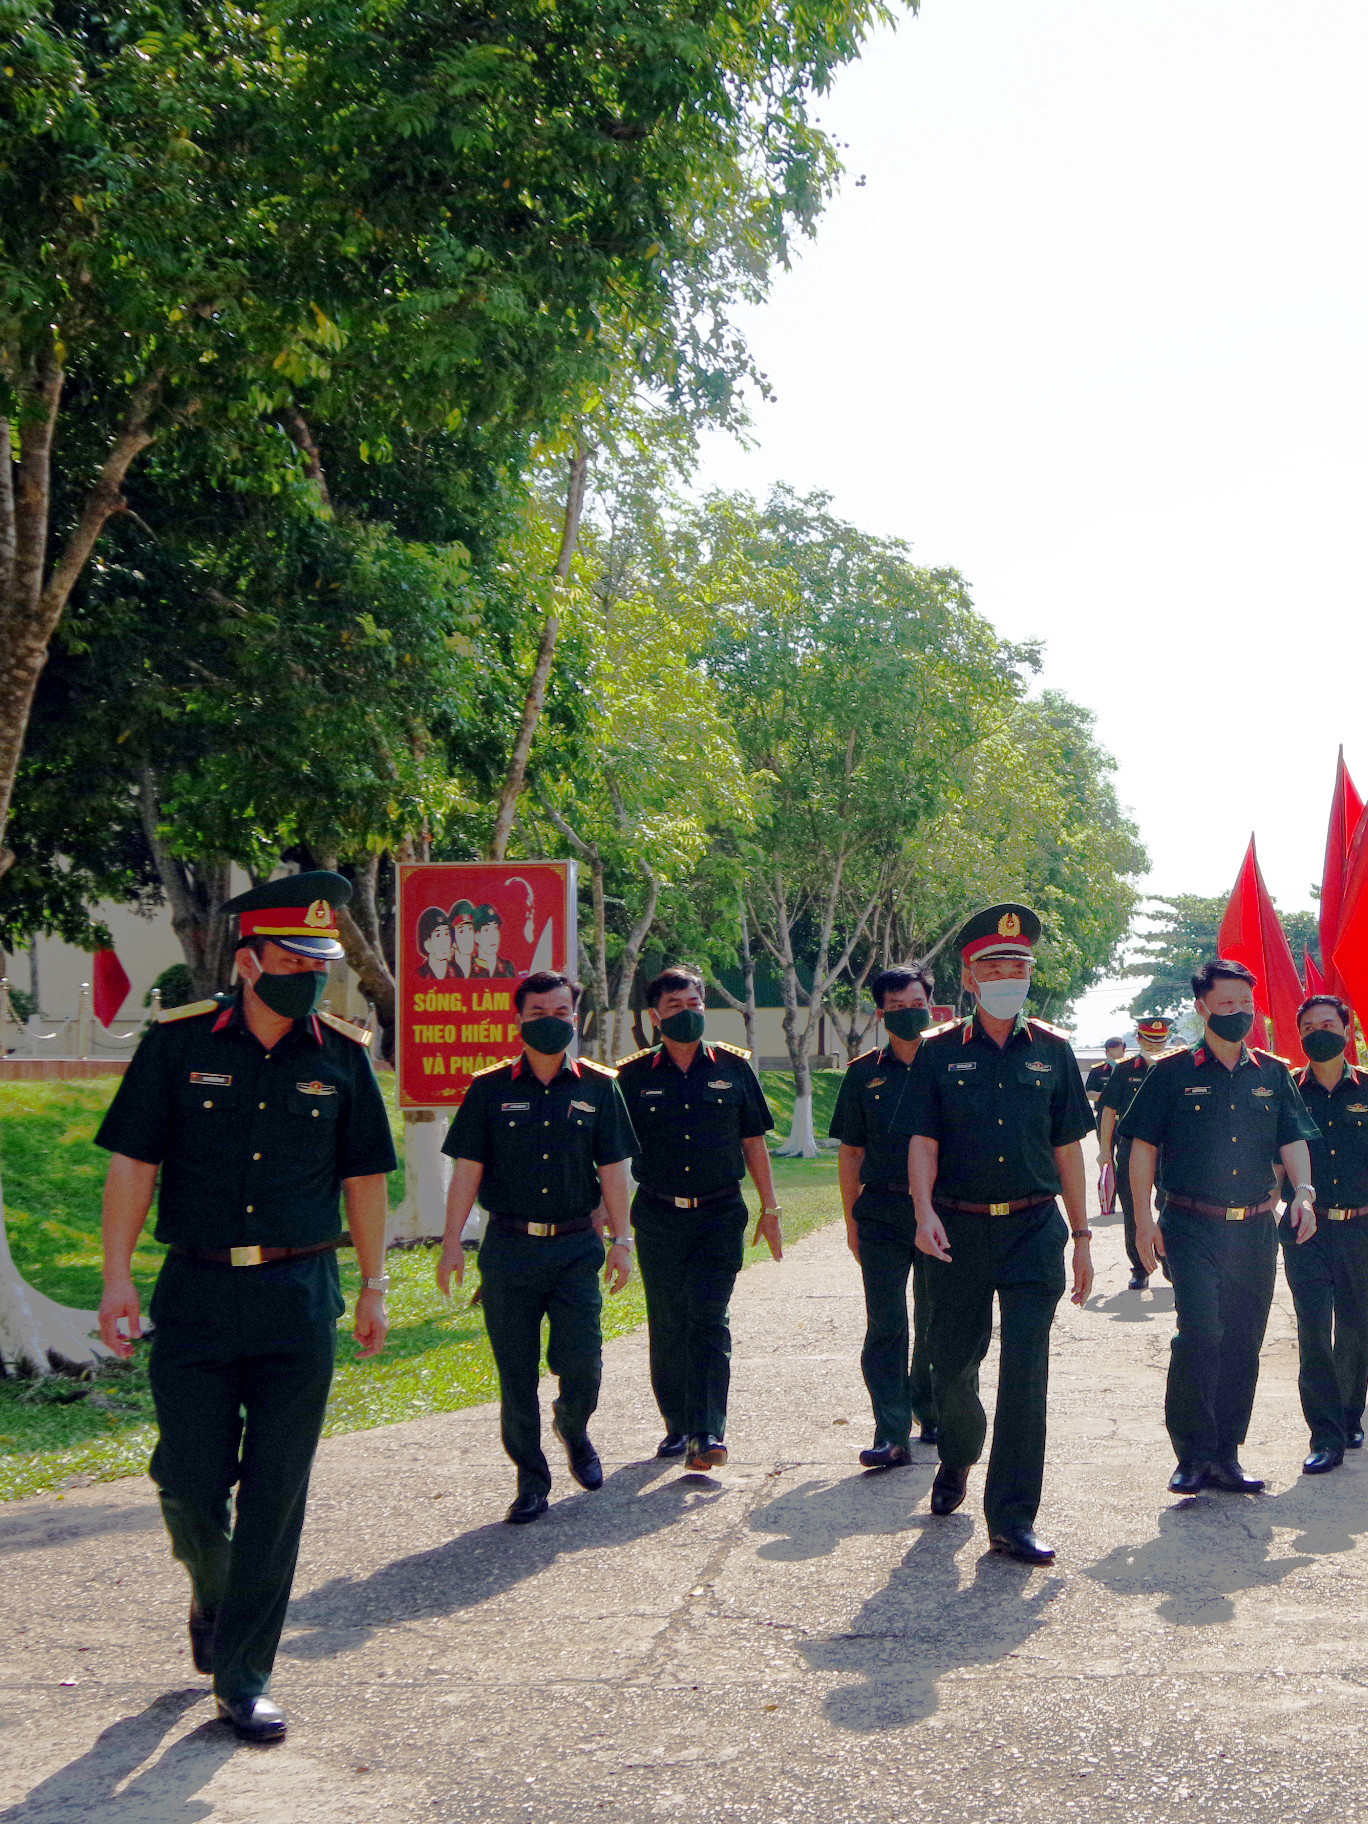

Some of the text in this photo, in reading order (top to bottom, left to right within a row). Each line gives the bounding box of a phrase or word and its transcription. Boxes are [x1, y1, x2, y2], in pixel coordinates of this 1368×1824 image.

[413, 986, 510, 1013] SỐNG, LÀM
[412, 1024, 456, 1043] THEO
[461, 1019, 503, 1043] HIẾN
[422, 1052, 446, 1075] VÀ
